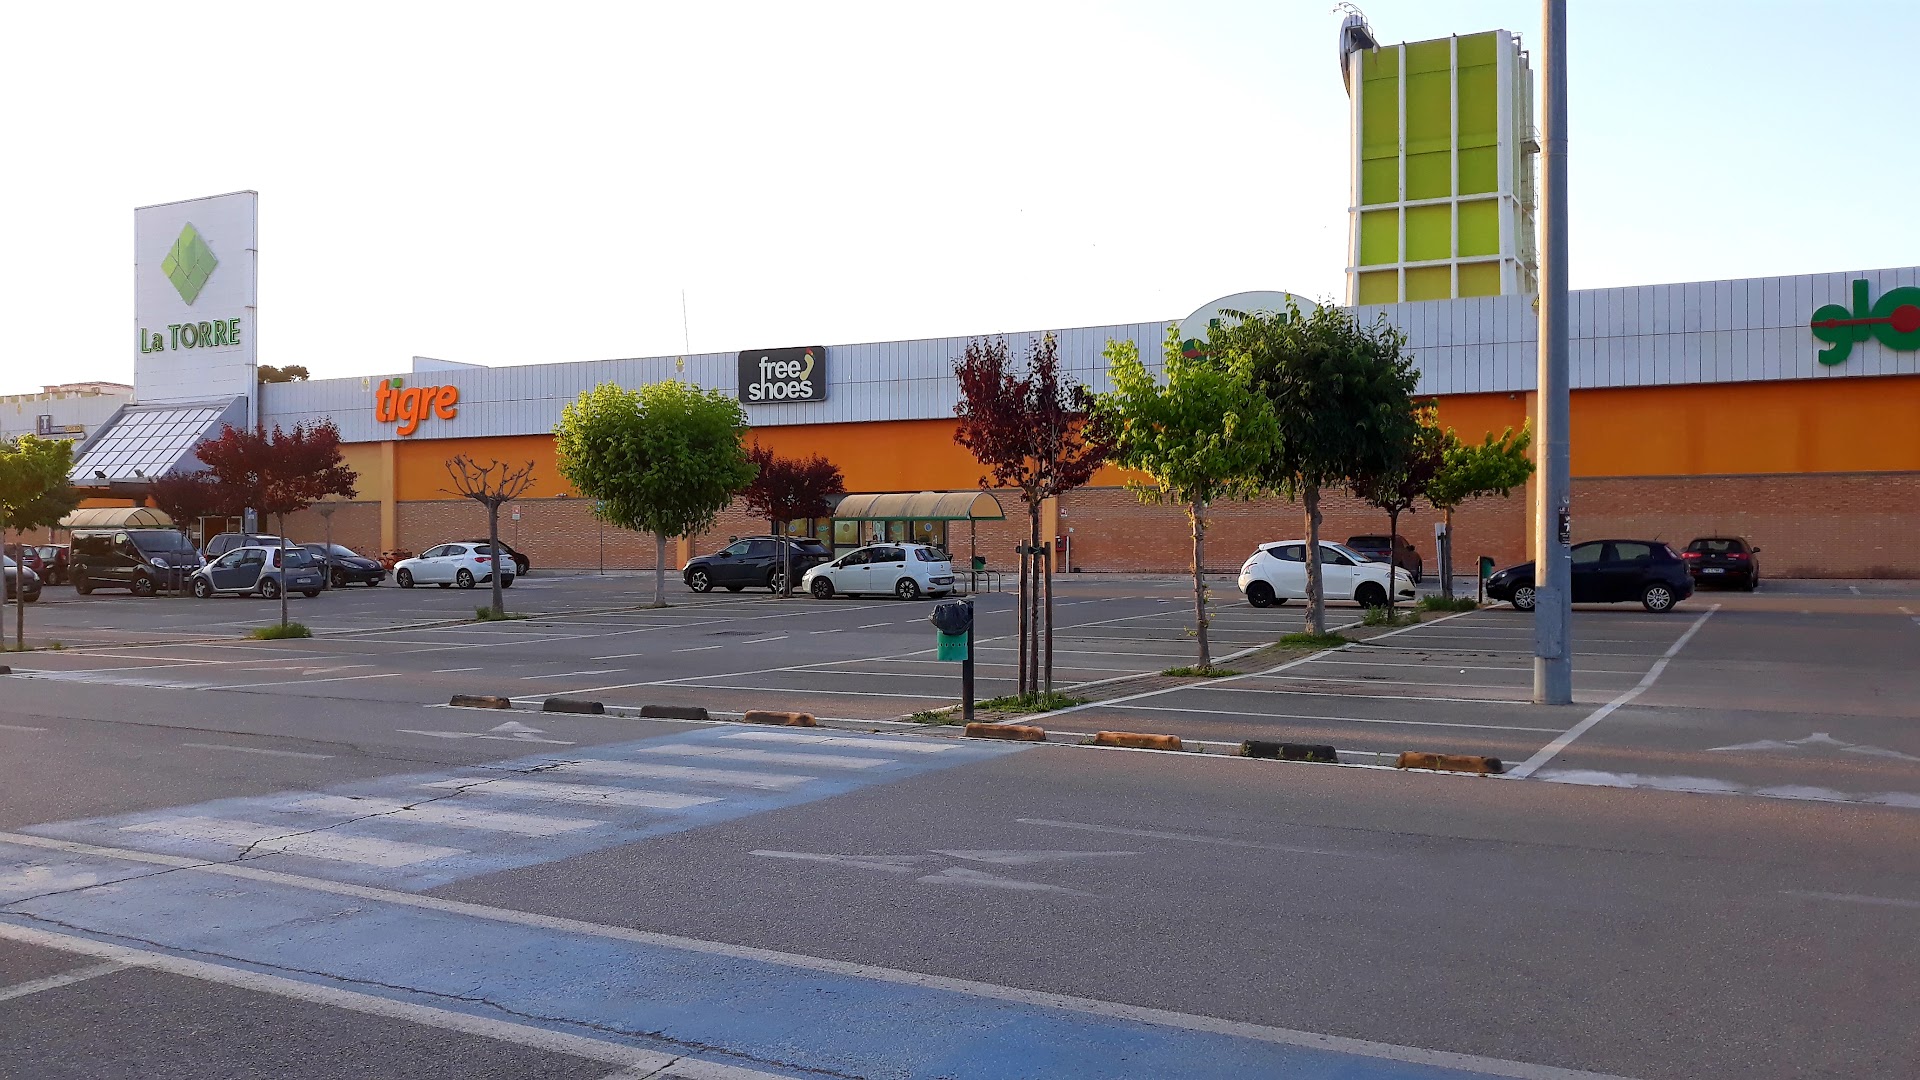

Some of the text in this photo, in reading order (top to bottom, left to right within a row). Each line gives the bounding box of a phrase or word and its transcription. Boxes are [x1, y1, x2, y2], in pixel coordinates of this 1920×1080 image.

[140, 318, 241, 353] La TORRE
[758, 356, 801, 380] free
[748, 379, 813, 401] shoes
[375, 378, 459, 436] tigre
